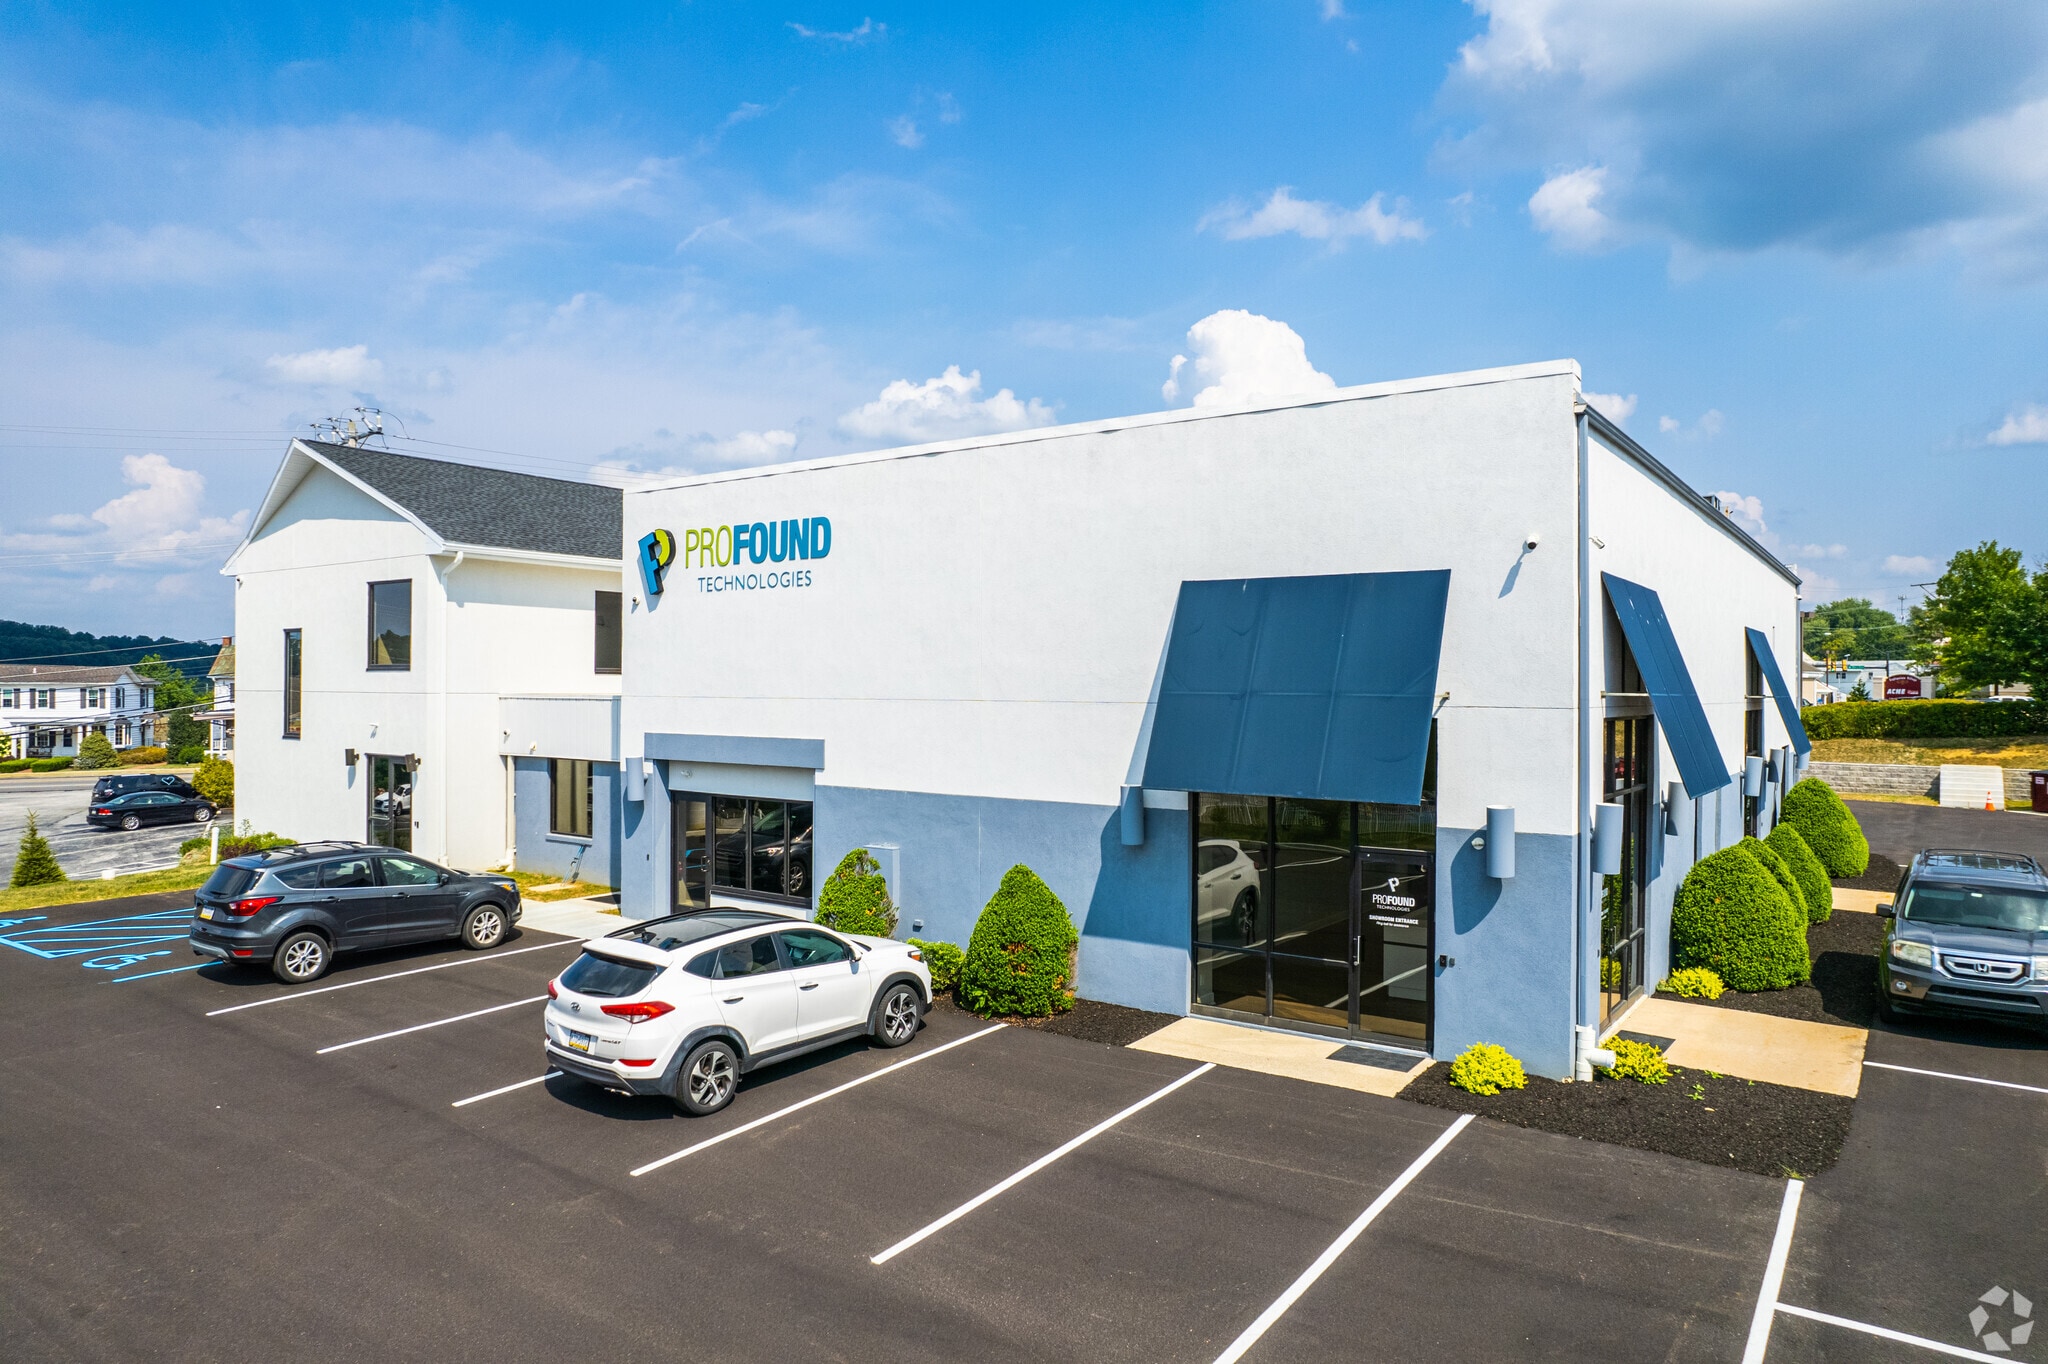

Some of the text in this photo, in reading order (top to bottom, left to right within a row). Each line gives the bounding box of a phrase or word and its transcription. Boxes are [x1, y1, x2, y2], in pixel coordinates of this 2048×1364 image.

[685, 516, 832, 569] PROFOUND
[698, 570, 812, 593] TECHNOLOGIES
[1372, 893, 1416, 907] PROFOUND
